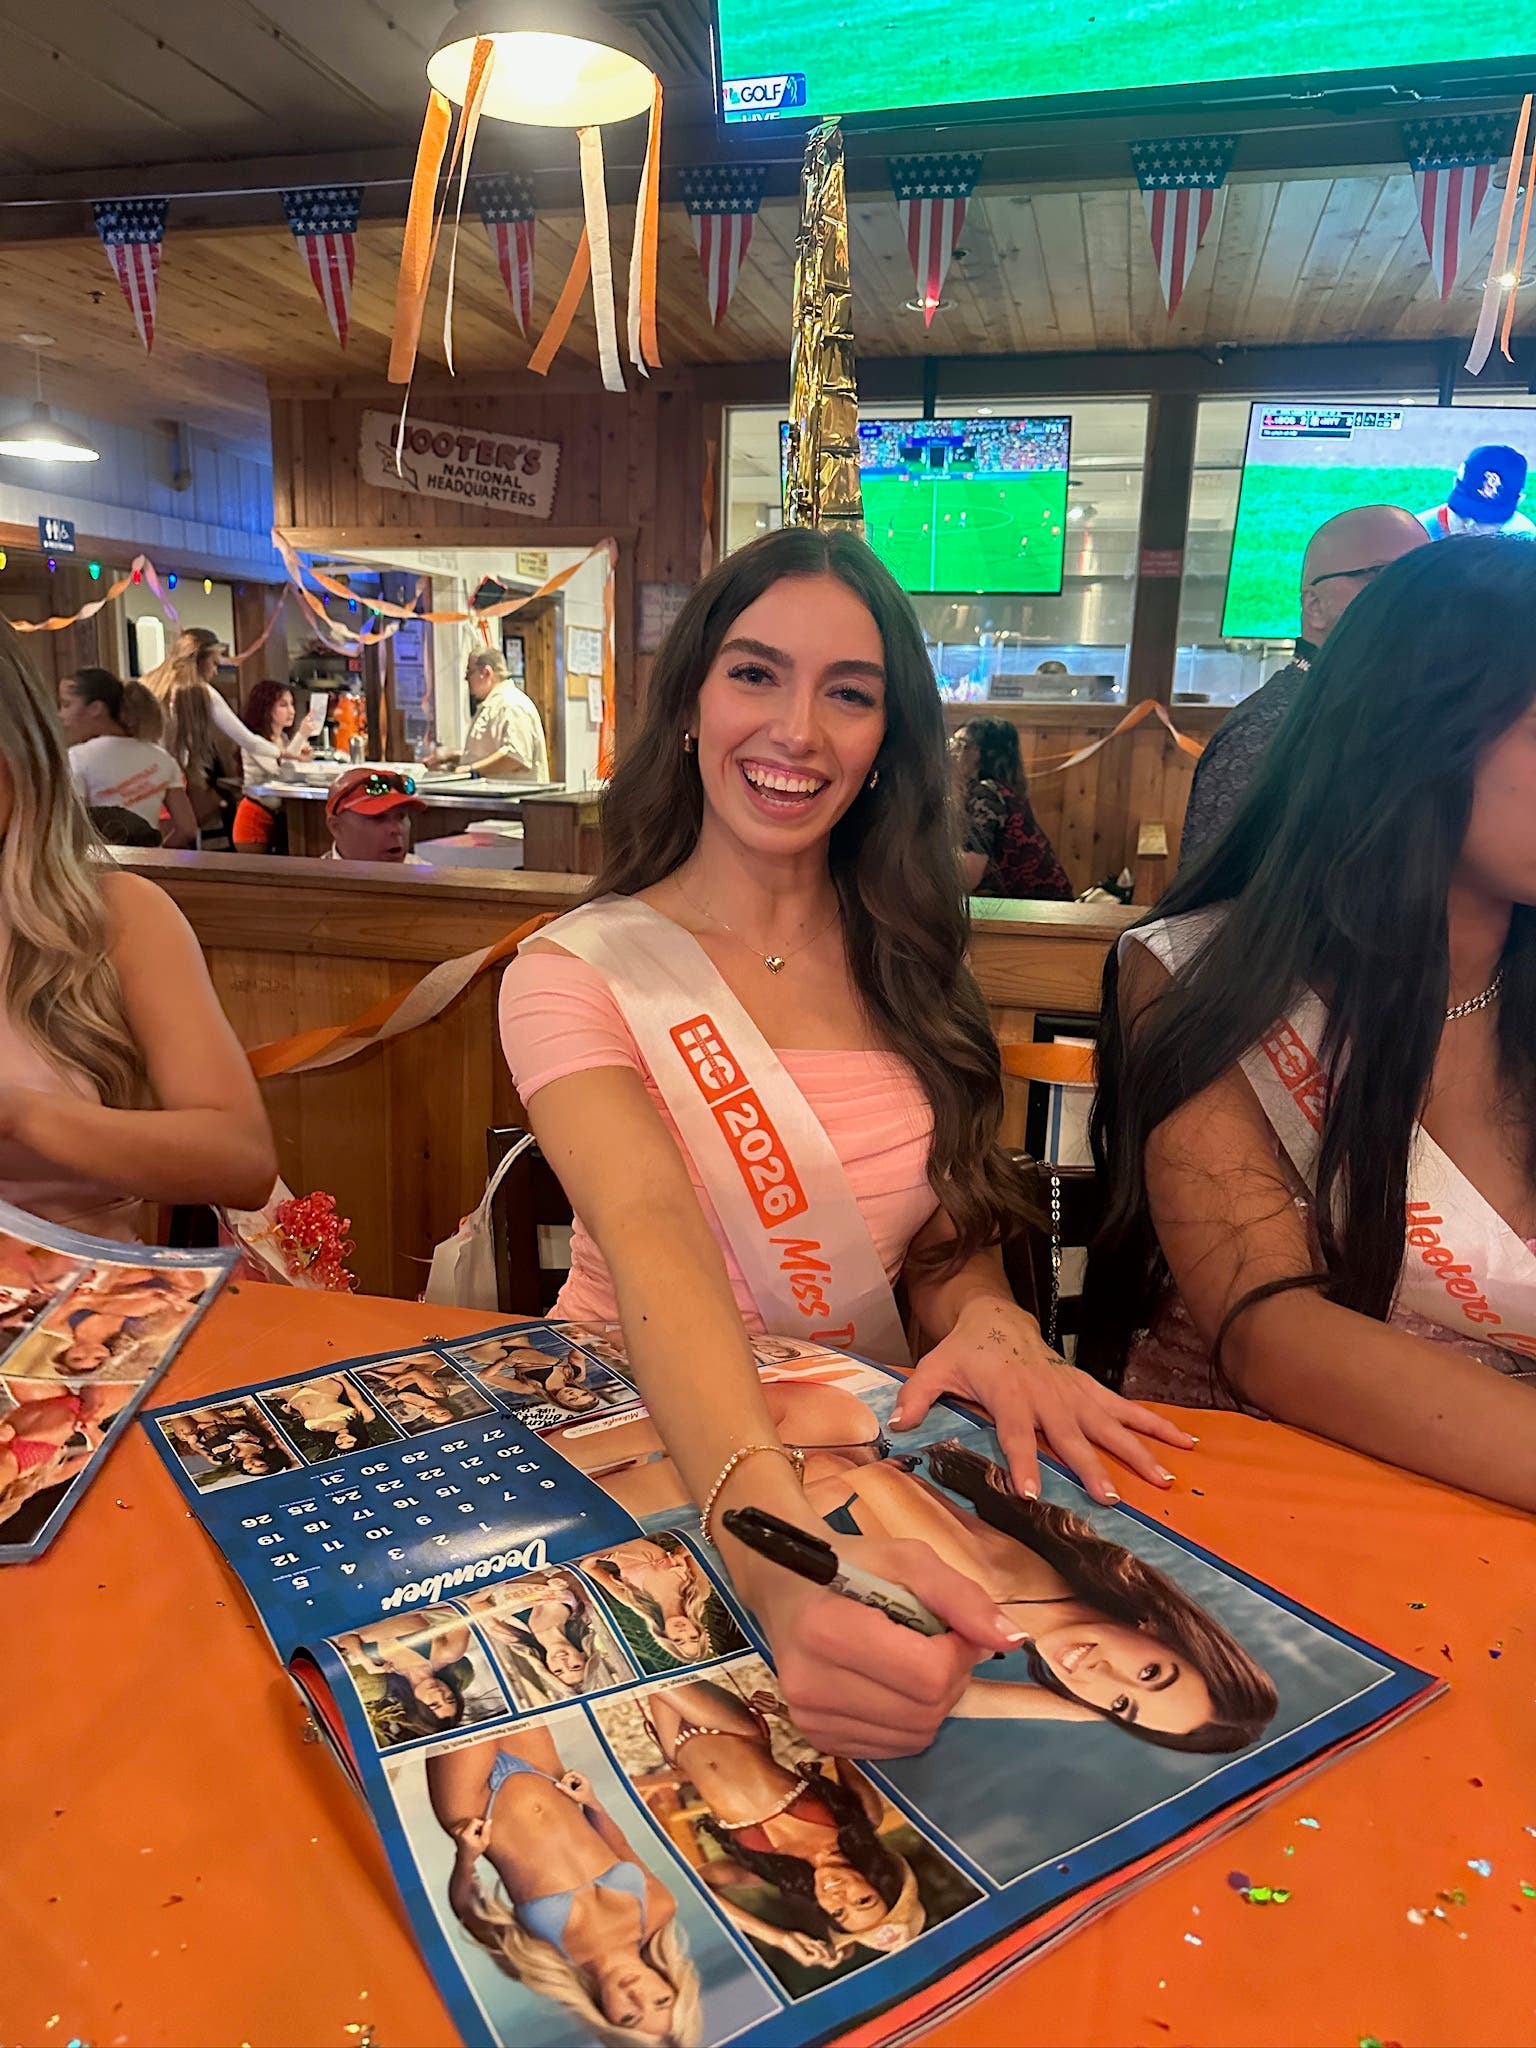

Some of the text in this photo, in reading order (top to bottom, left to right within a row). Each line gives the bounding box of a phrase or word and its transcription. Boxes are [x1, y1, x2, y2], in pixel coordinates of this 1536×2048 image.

[741, 84, 781, 103] GOLF
[443, 463, 522, 489] NATIONAL
[427, 475, 537, 507] HEADQUARTERS
[723, 1103, 797, 1217] 2026
[769, 1238, 832, 1317] Miss
[1405, 1201, 1501, 1324] Hooters
[482, 1429, 505, 1443] 27
[440, 1440, 469, 1453] 28
[496, 1445, 524, 1458] 20
[401, 1451, 429, 1464] 29
[459, 1456, 484, 1469] 21
[360, 1462, 390, 1476] 30
[416, 1467, 446, 1481] 22
[516, 1462, 541, 1473] 13
[320, 1474, 345, 1487] 31
[476, 1472, 502, 1485] 14
[539, 1479, 556, 1489] 6
[375, 1479, 405, 1493] 23
[435, 1485, 461, 1498] 15
[332, 1490, 362, 1505] 24
[392, 1497, 420, 1509] 16
[503, 1491, 517, 1502] 7
[287, 1502, 318, 1516] 25
[352, 1508, 375, 1521] 17
[457, 1503, 475, 1513] 8
[241, 1514, 273, 1528] 26
[303, 1520, 331, 1534] 18
[415, 1515, 433, 1526] 9
[365, 1526, 393, 1540] 10
[478, 1522, 493, 1533] 1
[257, 1533, 285, 1546] 19
[431, 1534, 450, 1546] 2
[321, 1540, 345, 1553] 11
[270, 1552, 300, 1567] 12
[387, 1548, 406, 1561] 3
[340, 1563, 357, 1575] 4
[381, 1538, 552, 1611] December
[291, 1576, 310, 1590] 5
